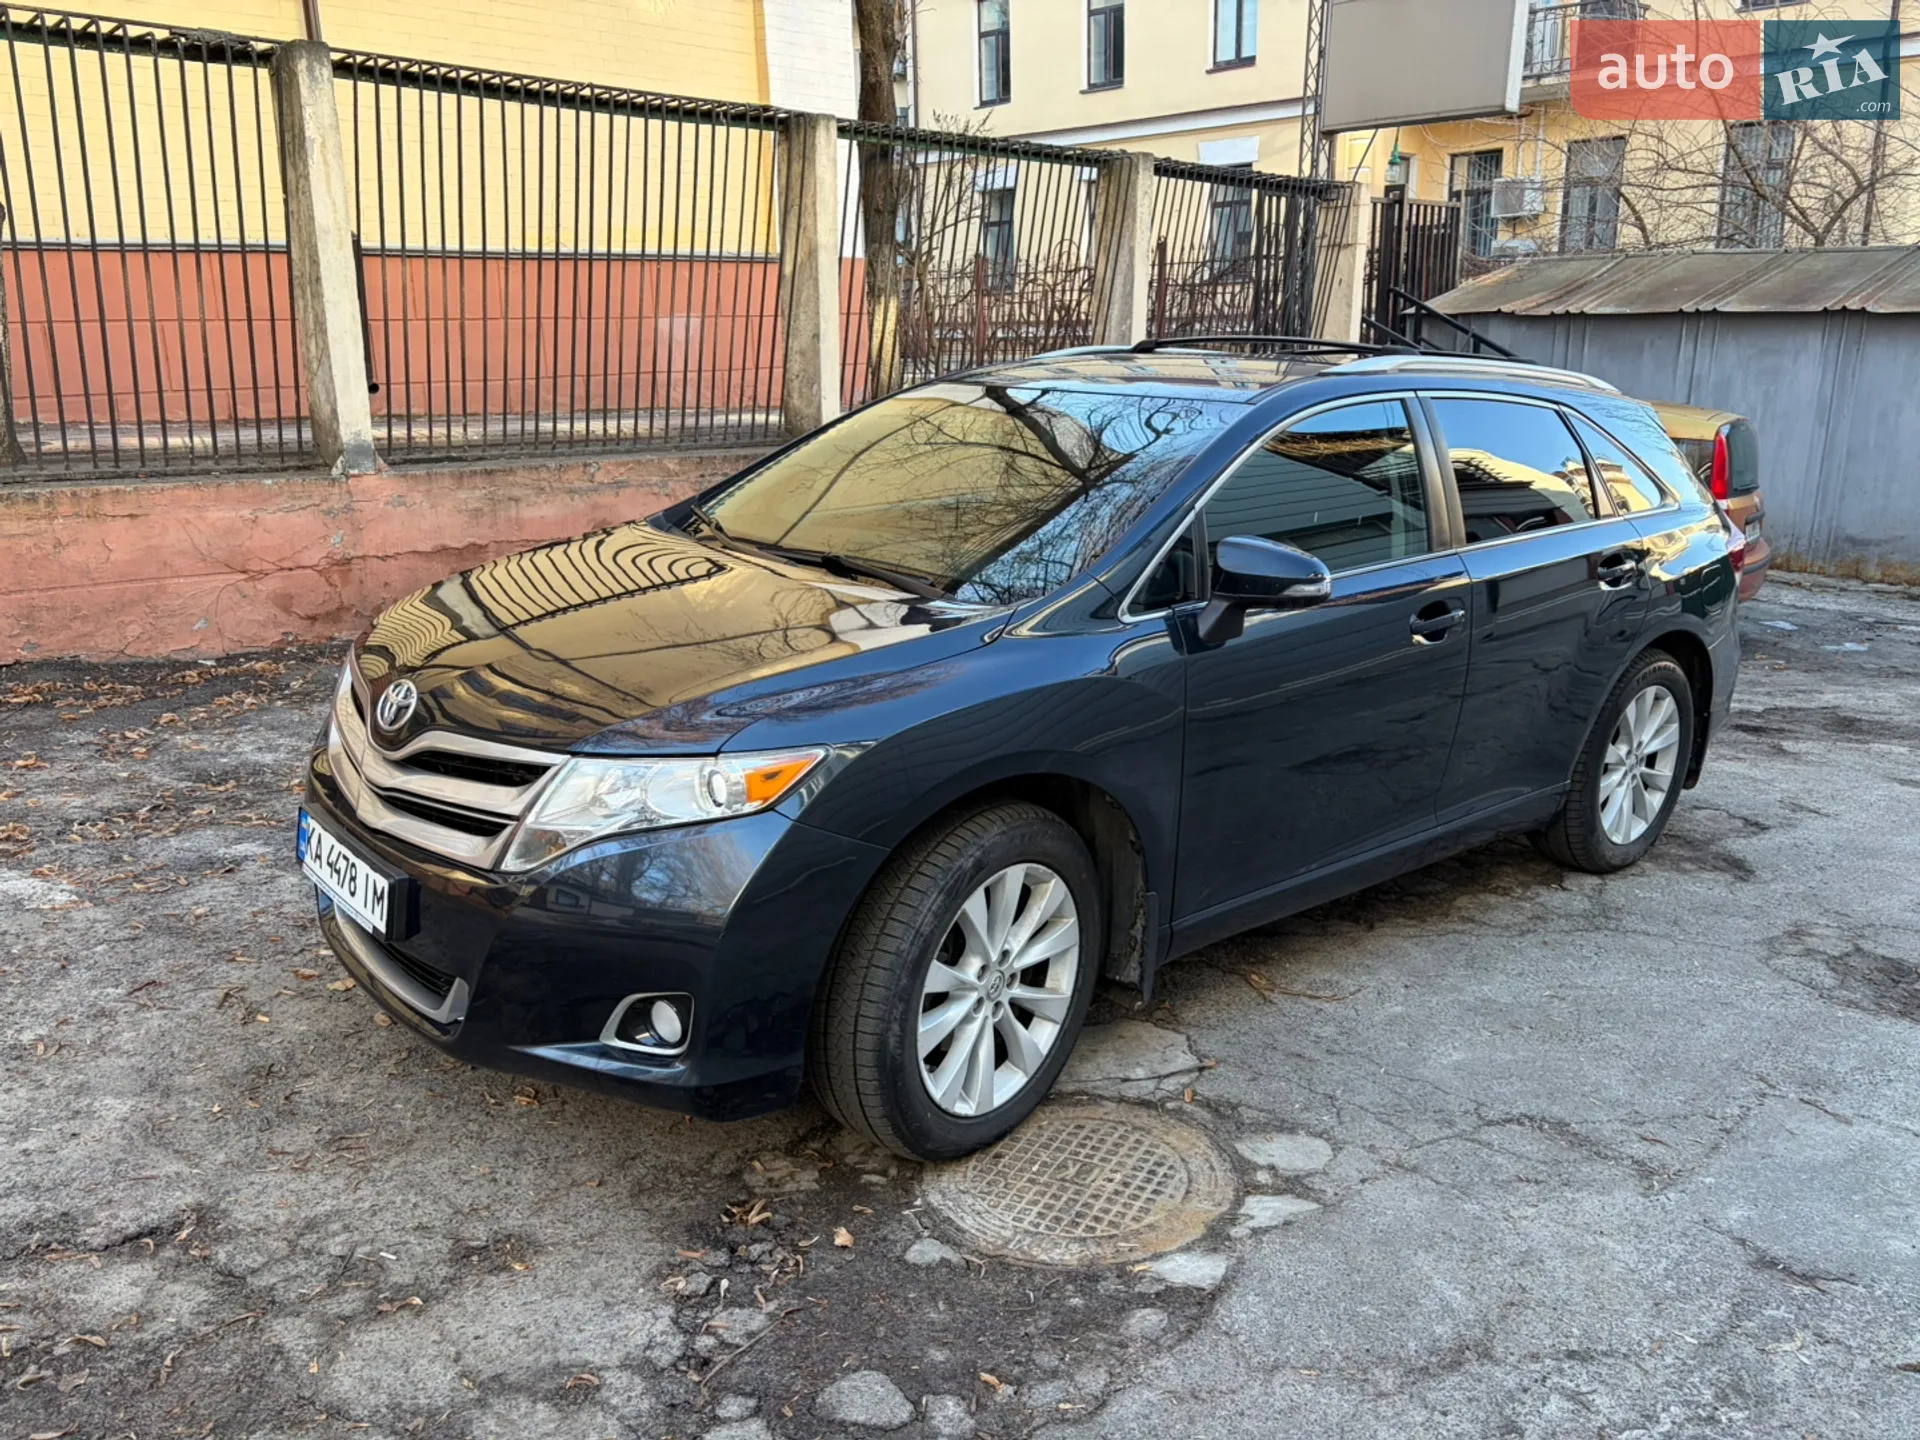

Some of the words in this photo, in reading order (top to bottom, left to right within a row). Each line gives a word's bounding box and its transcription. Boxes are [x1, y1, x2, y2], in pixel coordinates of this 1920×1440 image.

[306, 827, 323, 870] KA
[326, 843, 358, 898] 4478
[363, 872, 386, 922] IM
